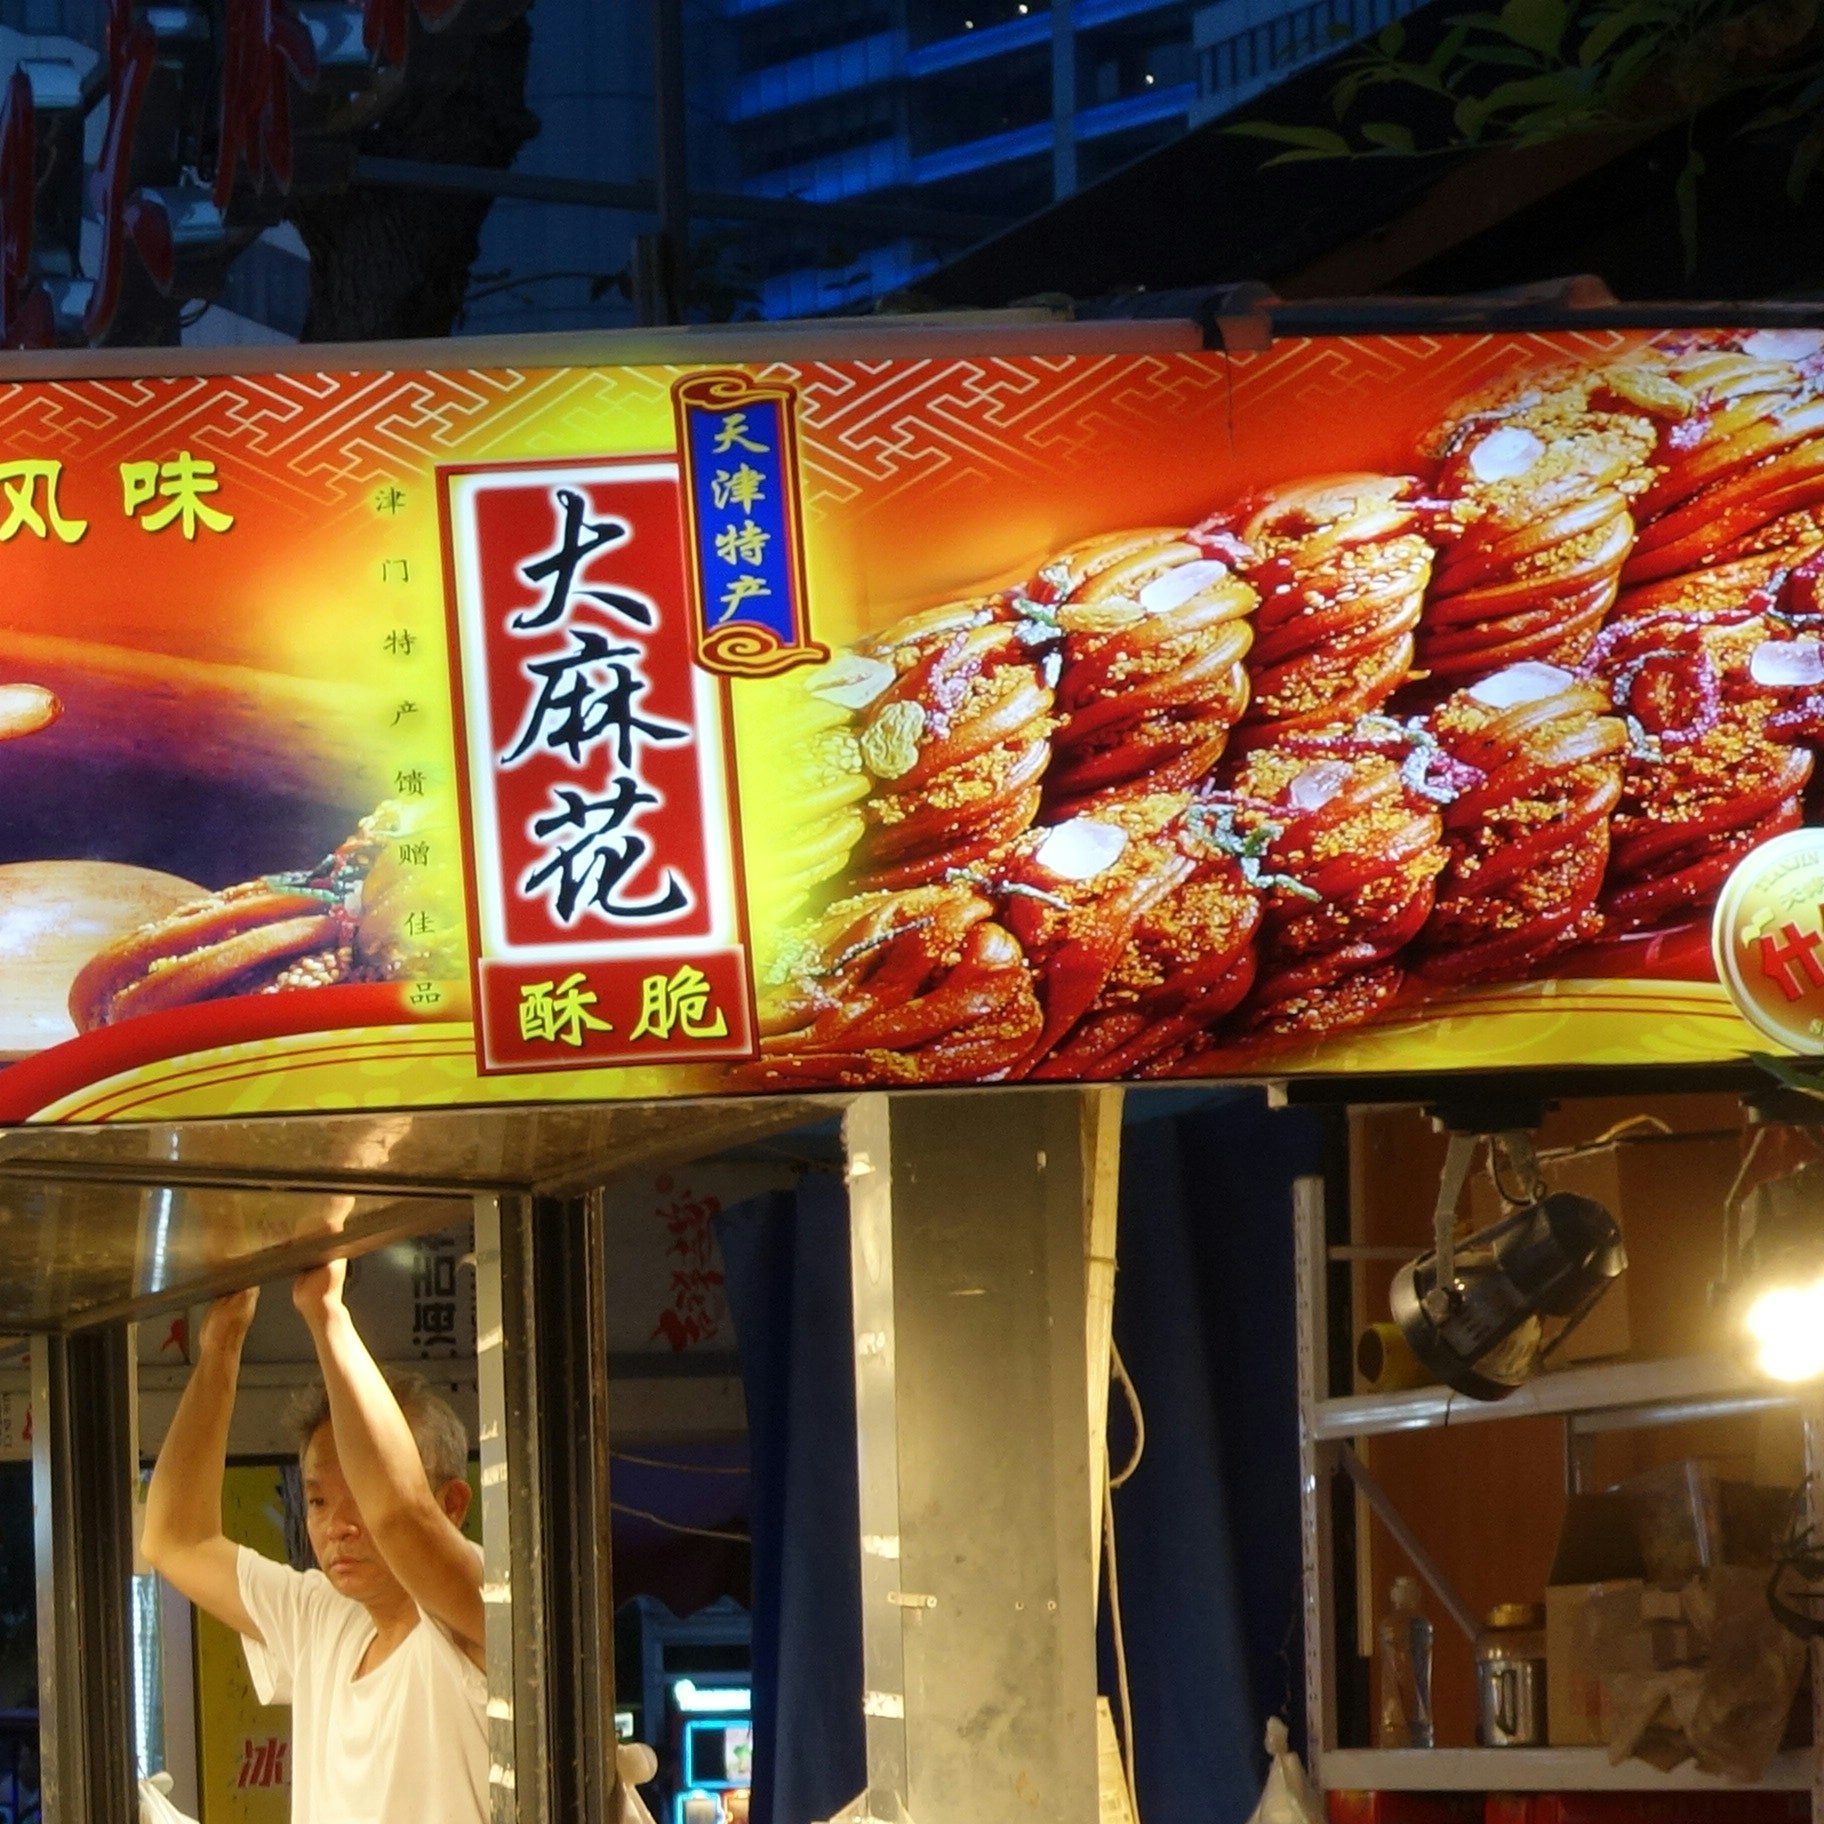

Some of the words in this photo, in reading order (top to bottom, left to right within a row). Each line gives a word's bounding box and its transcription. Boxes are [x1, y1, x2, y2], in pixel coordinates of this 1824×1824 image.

[710, 412, 772, 626] 天津特产
[375, 485, 441, 1006] 津门特产馈赠佳品
[499, 488, 690, 927] 大麻花
[514, 962, 729, 1052] 酥脆
[237, 1737, 289, 1788] 冰
